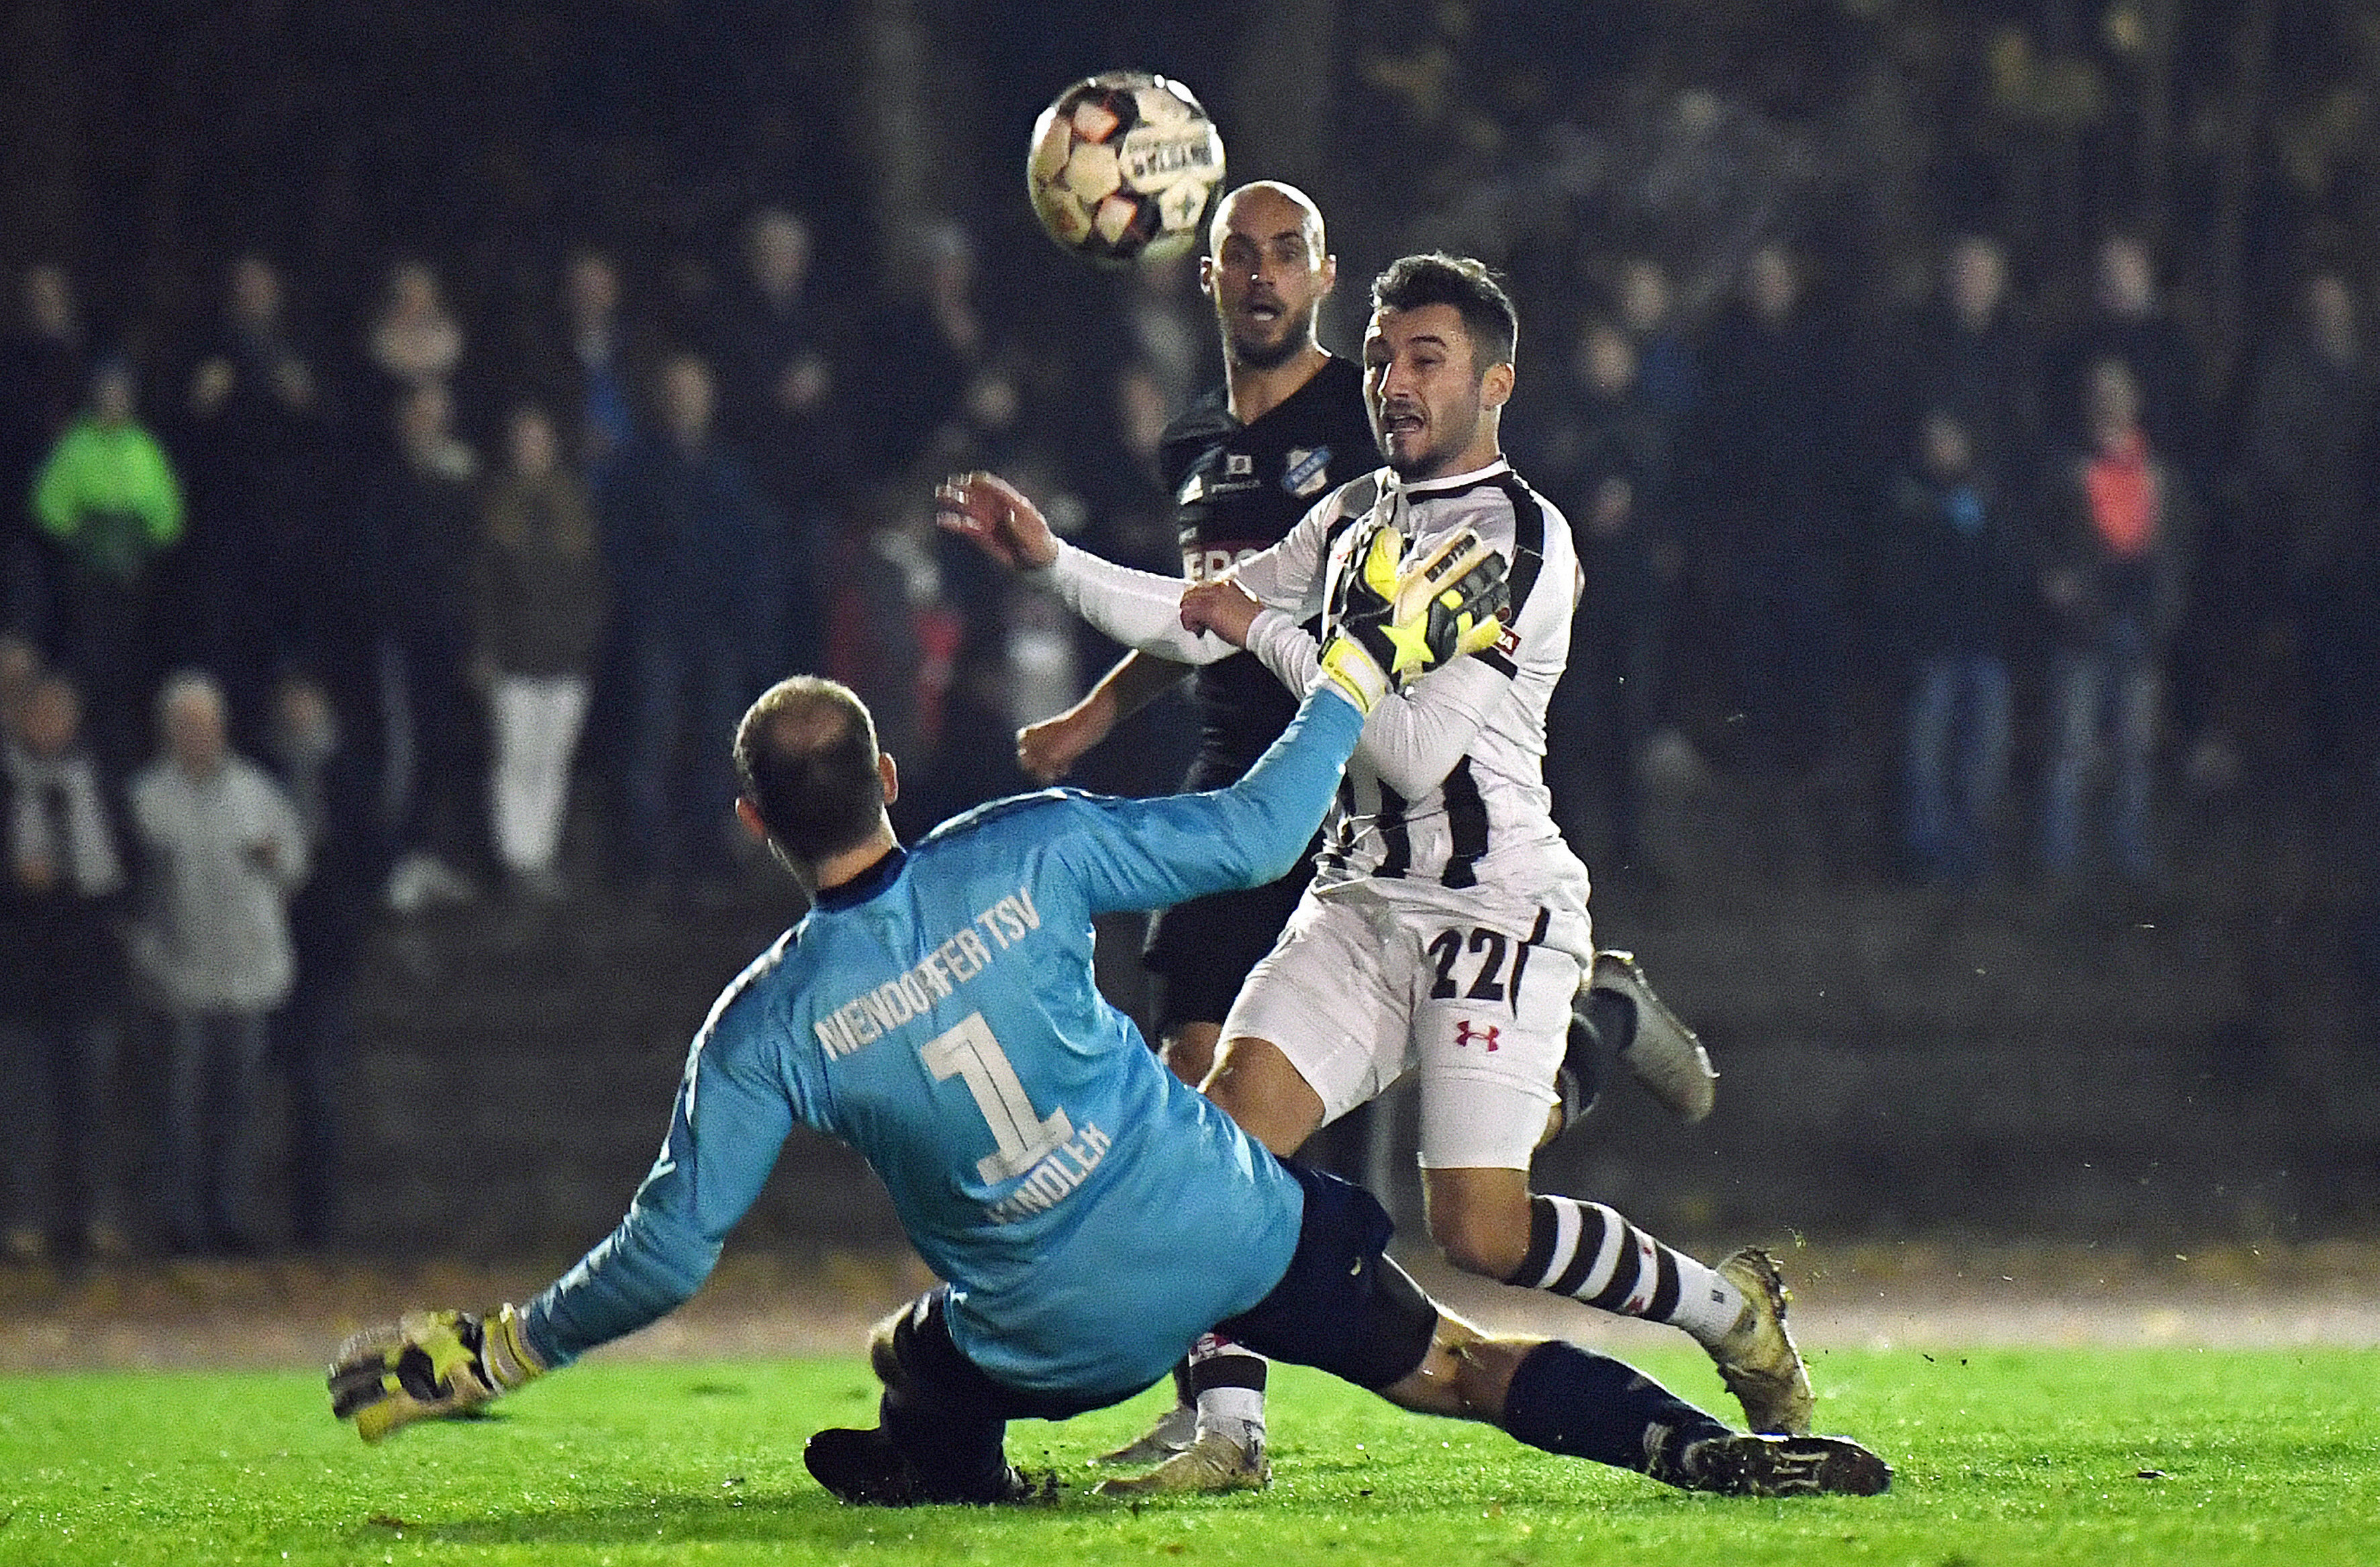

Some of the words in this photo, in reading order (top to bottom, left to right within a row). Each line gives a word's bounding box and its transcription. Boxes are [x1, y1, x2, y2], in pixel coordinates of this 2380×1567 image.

[977, 886, 1041, 950] TSV
[1428, 927, 1506, 1001] 22
[921, 1011, 1075, 1187] 1
